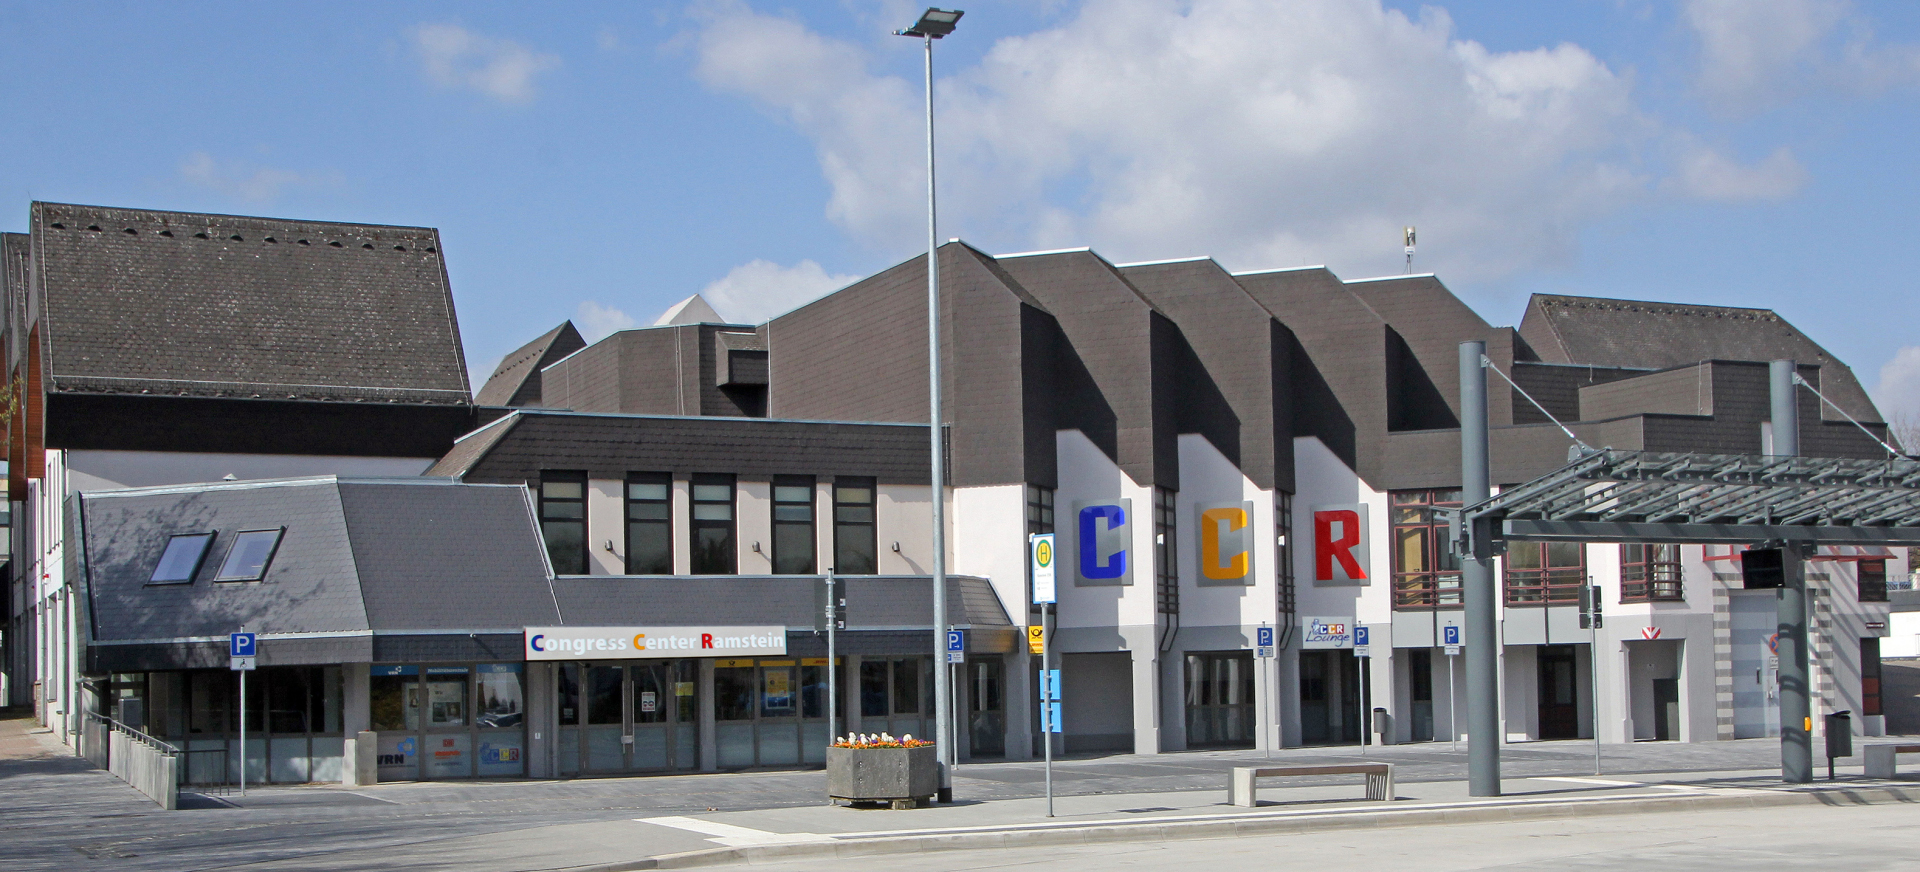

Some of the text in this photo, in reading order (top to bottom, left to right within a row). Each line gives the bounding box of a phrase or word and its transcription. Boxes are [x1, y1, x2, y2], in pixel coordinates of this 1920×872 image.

[1079, 505, 1126, 579] C
[1201, 507, 1248, 579] C
[1314, 509, 1367, 580] R
[1040, 545, 1048, 562] H
[1320, 624, 1344, 634] CCR
[1356, 629, 1366, 644] P
[1448, 628, 1456, 643] P
[236, 635, 250, 654] P
[530, 632, 784, 656] Congress Center Ramstein
[948, 633, 959, 649] P
[1260, 630, 1270, 645] P
[1305, 631, 1350, 647] Lounge
[490, 748, 519, 761] CCR
